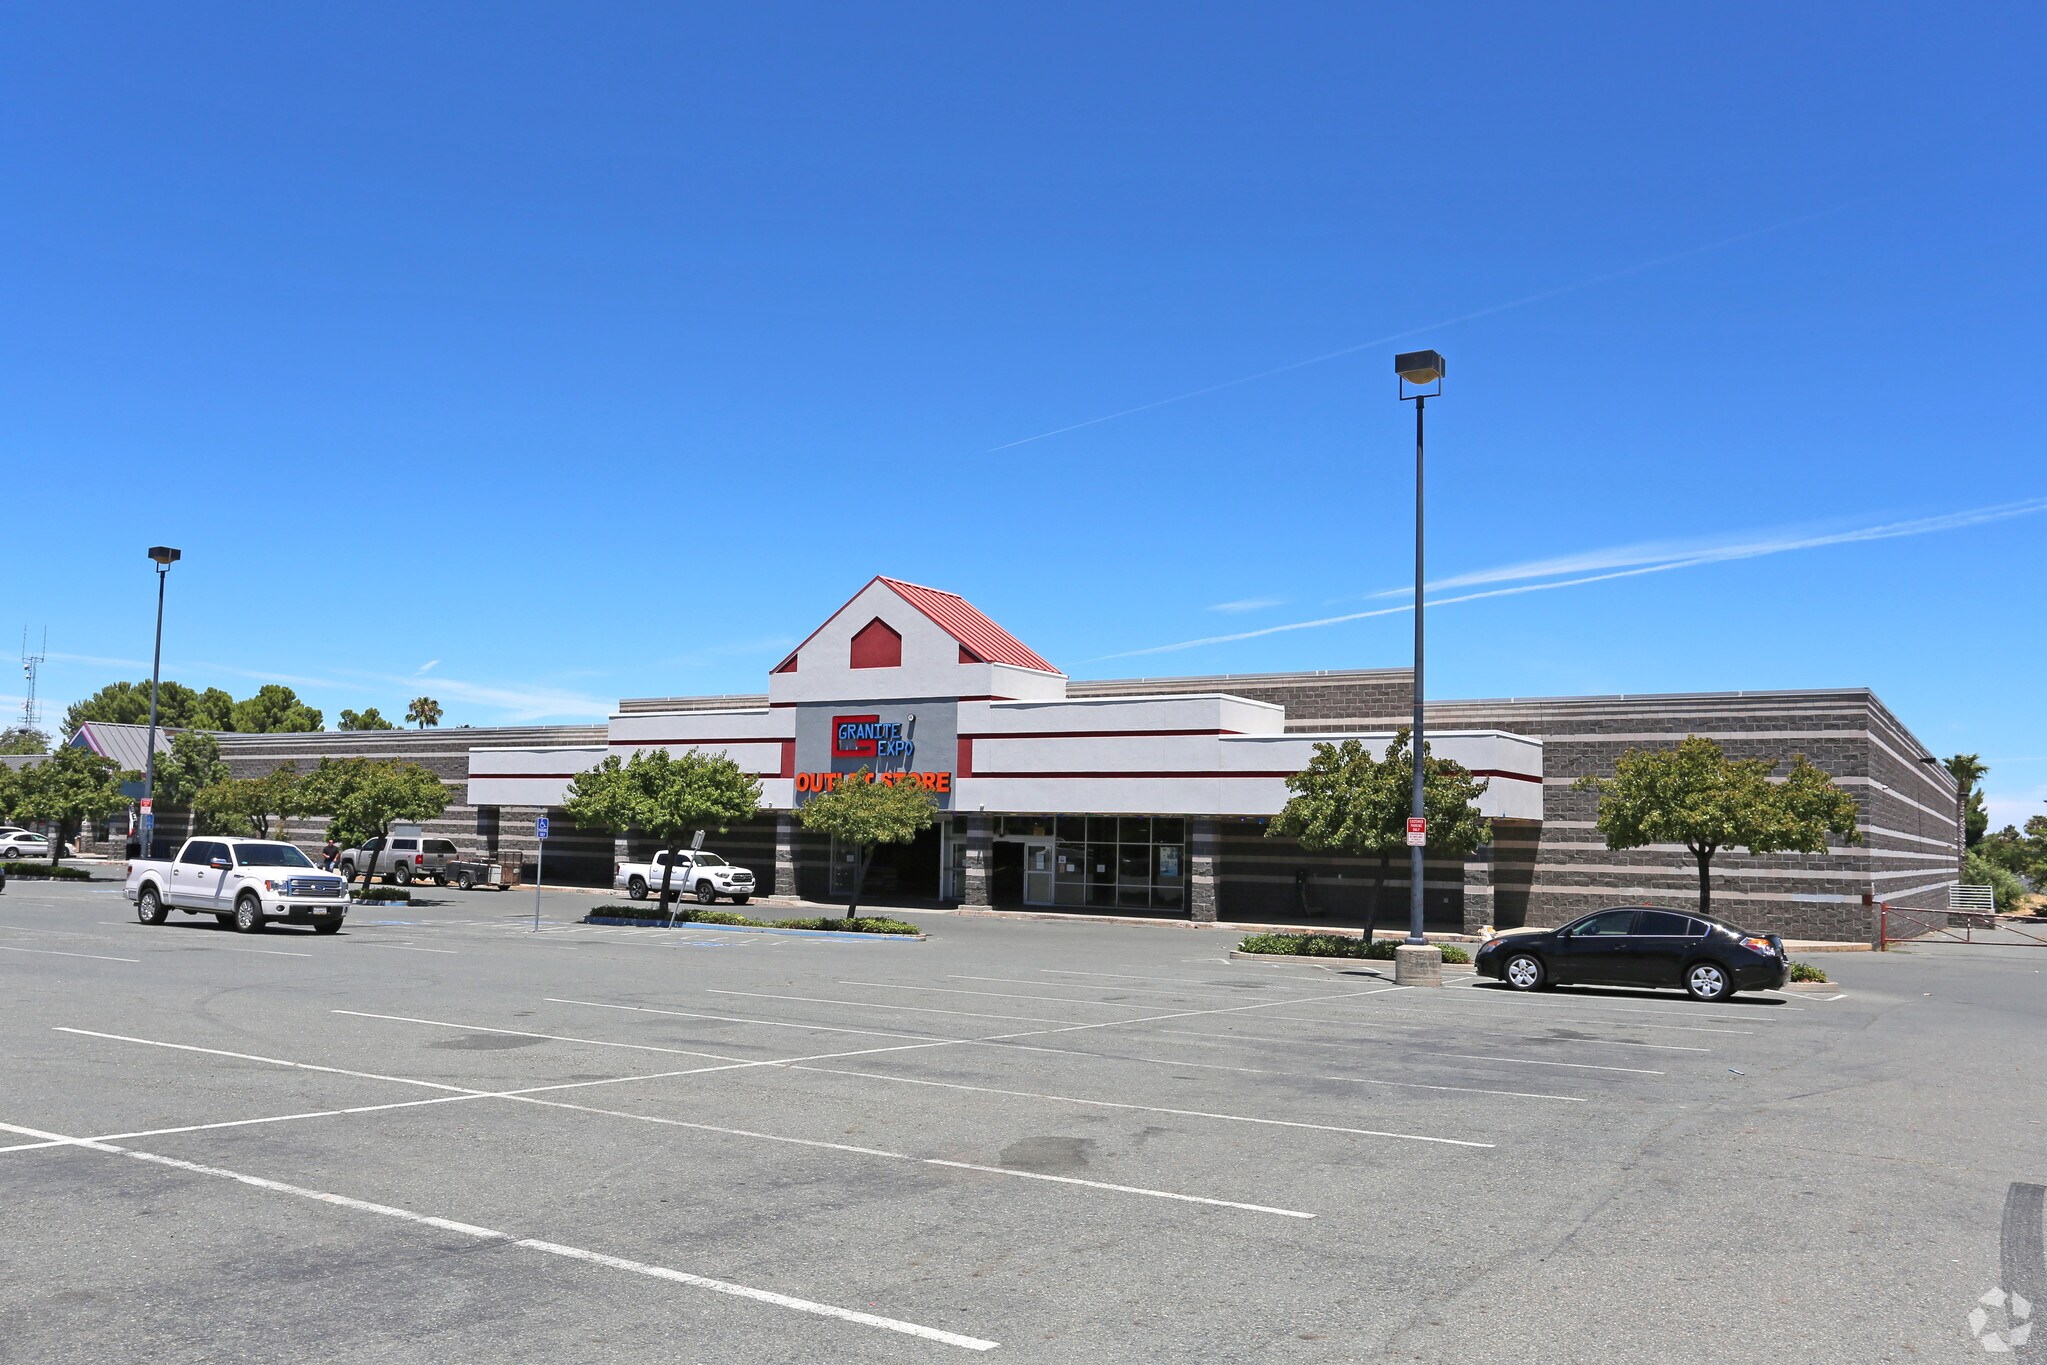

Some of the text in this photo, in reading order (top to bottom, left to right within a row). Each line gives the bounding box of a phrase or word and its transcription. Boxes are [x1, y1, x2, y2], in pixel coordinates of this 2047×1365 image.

[838, 723, 901, 740] GRANITE
[878, 740, 914, 756] EXPO
[795, 772, 875, 792] OUTT
